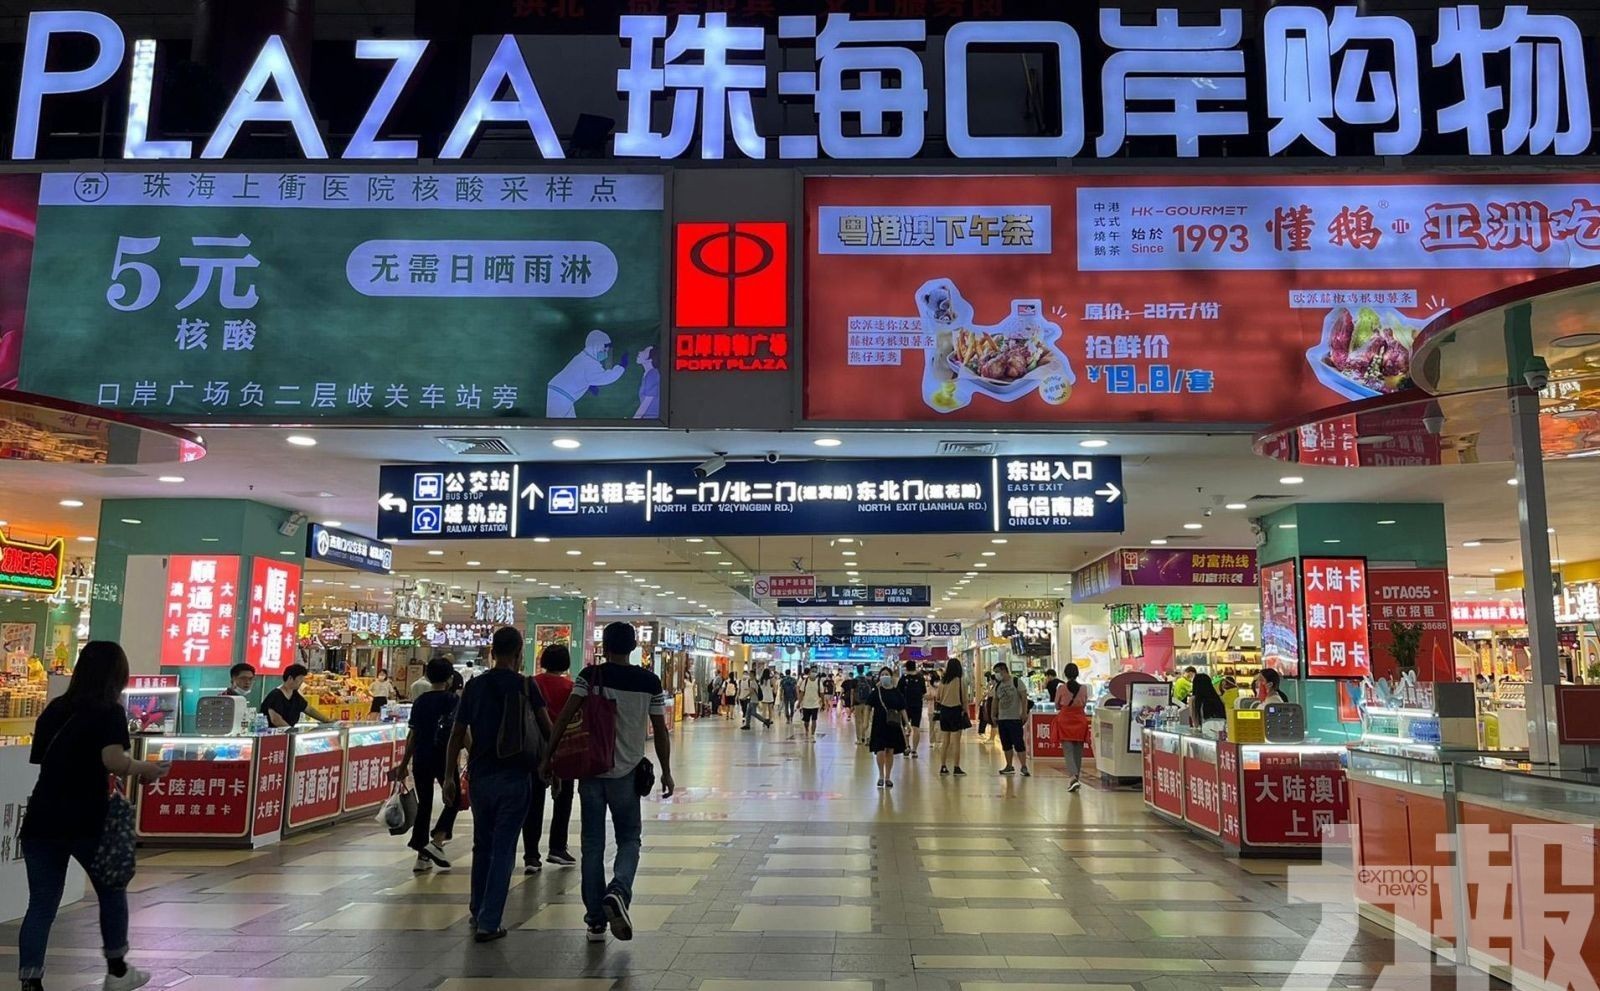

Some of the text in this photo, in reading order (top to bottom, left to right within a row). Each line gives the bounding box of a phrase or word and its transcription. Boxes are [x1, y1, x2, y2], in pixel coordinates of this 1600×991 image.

[11, 5, 1590, 160] PLAZA 珠海口岸购物
[1132, 206, 1248, 216] HK-GOURMET
[838, 215, 1033, 246] 粤港澳下午茶
[1131, 225, 1249, 252] 始於 1993
[1131, 243, 1163, 253] Since
[106, 233, 260, 312] 5元
[371, 254, 592, 283] 无需日晒雨淋
[1144, 302, 1219, 320] 28元/份
[175, 318, 257, 351] 核酸
[1086, 335, 1169, 358] 抢鲜价
[676, 359, 788, 371] PORT PLAZA
[97, 381, 519, 410] 口岸广场负二层岐关车站旁
[1007, 461, 1093, 481] 东出入口
[445, 471, 510, 492] 公交站
[1039, 483, 1062, 491] EXIT
[464, 492, 484, 500] STOP
[580, 483, 646, 503] 出租车
[444, 504, 508, 524] 城轨站
[581, 506, 608, 514] TAXI
[654, 504, 686, 512] NORTH
[692, 504, 713, 512] EXIT
[858, 503, 891, 512] NORTH
[1008, 496, 1095, 517] 情侣南路
[446, 523, 508, 533] RAILWAY STATION
[1008, 517, 1071, 526] QINGLV RD.
[1192, 554, 1249, 568] 财富热线
[1307, 566, 1361, 593] 大陆卡
[1382, 586, 1431, 600] DTA055
[182, 560, 217, 662] 順通商行
[262, 567, 288, 668] 順通
[1309, 603, 1364, 630] 澳门卡
[1382, 605, 1435, 617] 柜位招租
[807, 620, 833, 636] 美食
[854, 621, 904, 636] 生活超市
[1373, 623, 1389, 631] TEL
[1311, 640, 1366, 667] 上网卡
[347, 756, 390, 794] 順通商行
[149, 777, 246, 797] 大陸澳門卡
[292, 766, 340, 807] 順通商行
[160, 803, 232, 816] 無限流量卡
